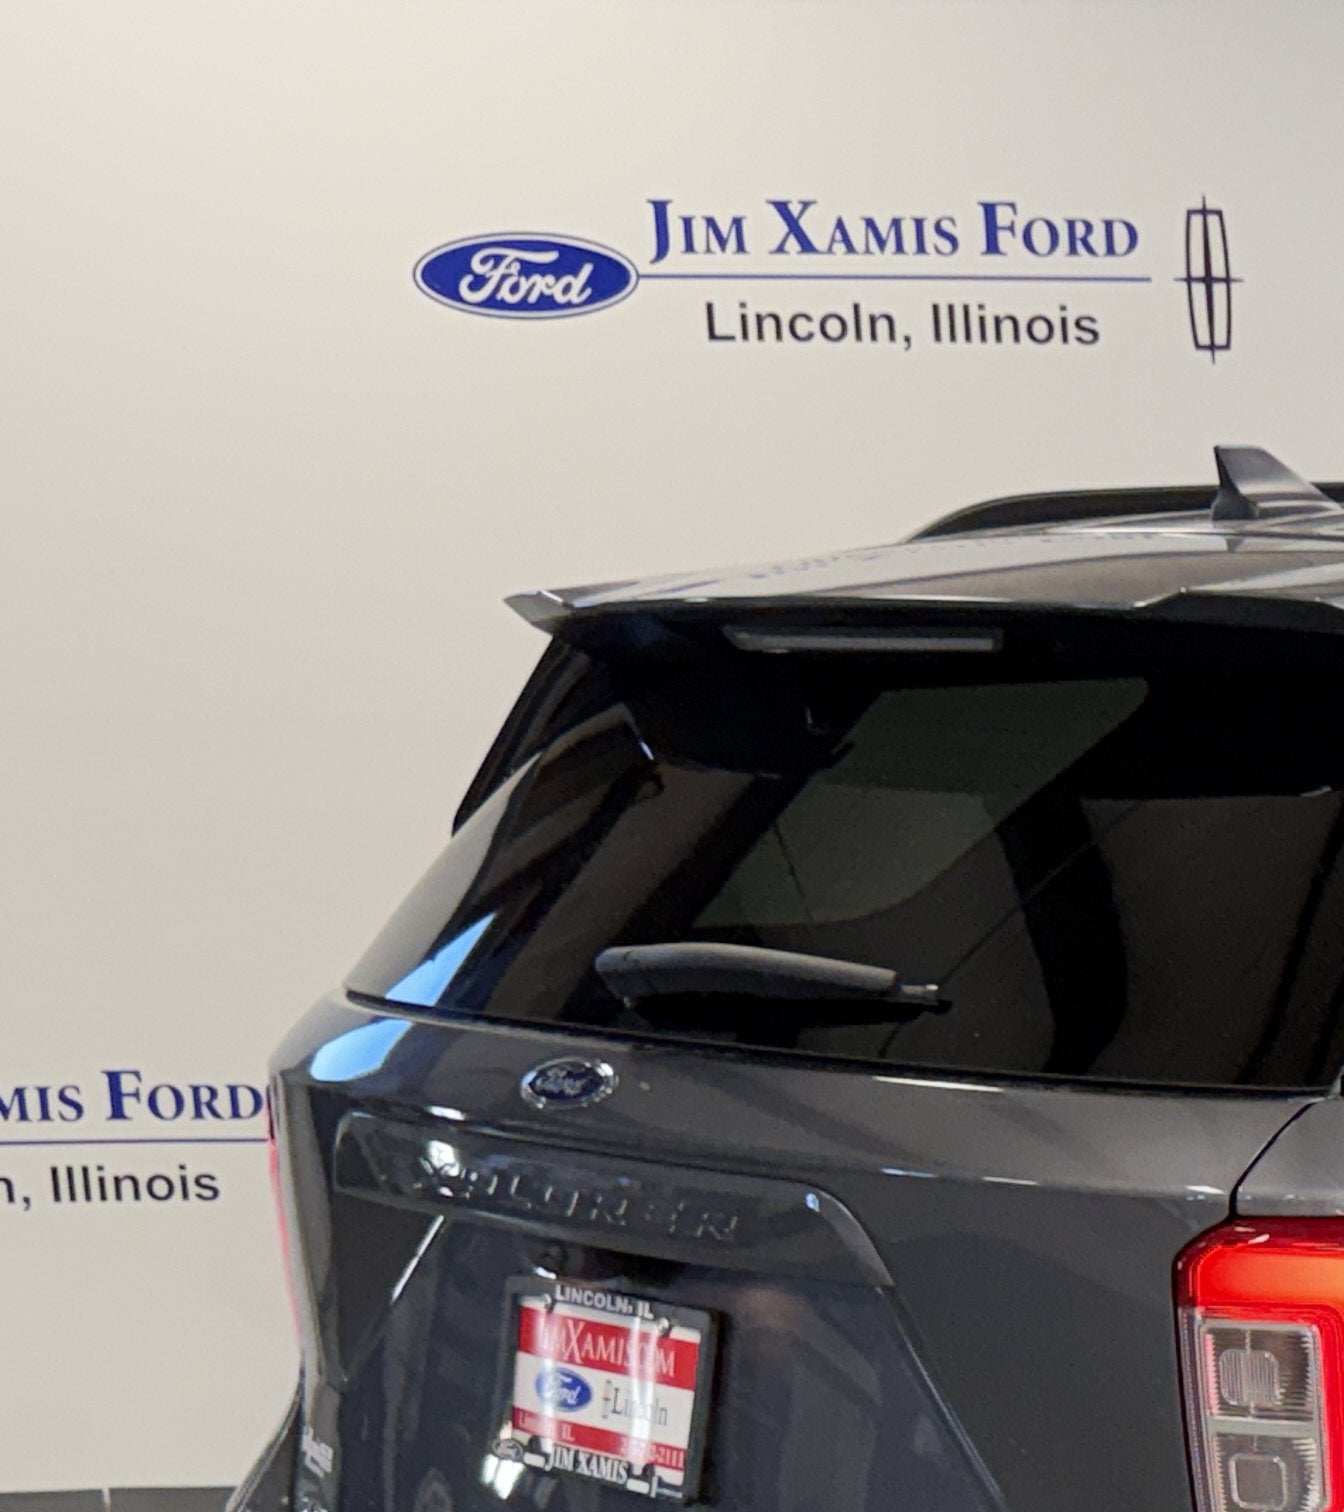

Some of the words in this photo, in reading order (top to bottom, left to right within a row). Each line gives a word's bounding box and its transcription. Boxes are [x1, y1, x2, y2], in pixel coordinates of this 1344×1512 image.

[648, 199, 749, 264] JIM
[766, 200, 960, 258] XAMIS
[978, 202, 1139, 258] FORD
[458, 249, 593, 305] Ford
[706, 302, 913, 352] Lincoln,
[932, 303, 1101, 347] Illinois
[102, 1070, 264, 1122] FORD
[50, 1164, 221, 1204] Illinois
[637, 1300, 655, 1320] IL
[575, 1450, 630, 1485] XAMIS
